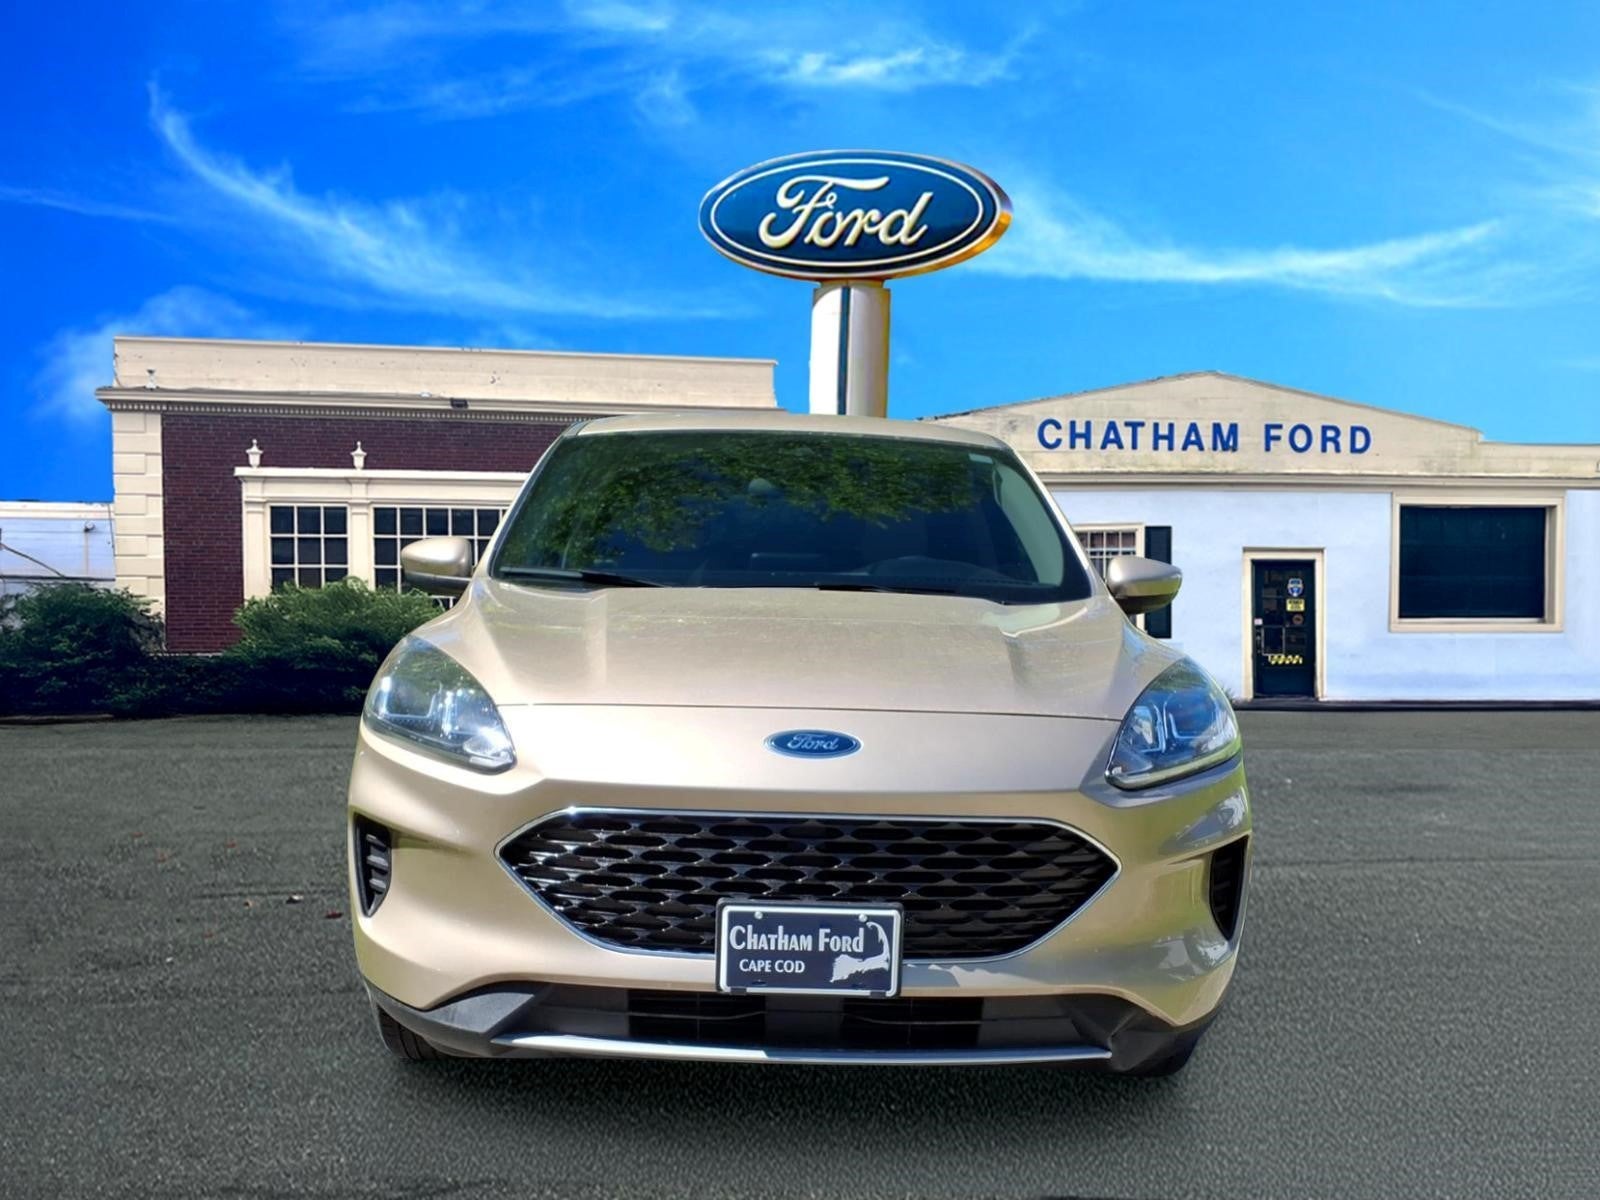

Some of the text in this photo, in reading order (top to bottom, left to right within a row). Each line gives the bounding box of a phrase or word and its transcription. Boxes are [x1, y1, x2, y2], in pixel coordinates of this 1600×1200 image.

[758, 174, 934, 248] Ford
[1037, 418, 1372, 455] CHATHAM FORD
[787, 733, 839, 750] Ford
[739, 959, 806, 973] CAPE COD
